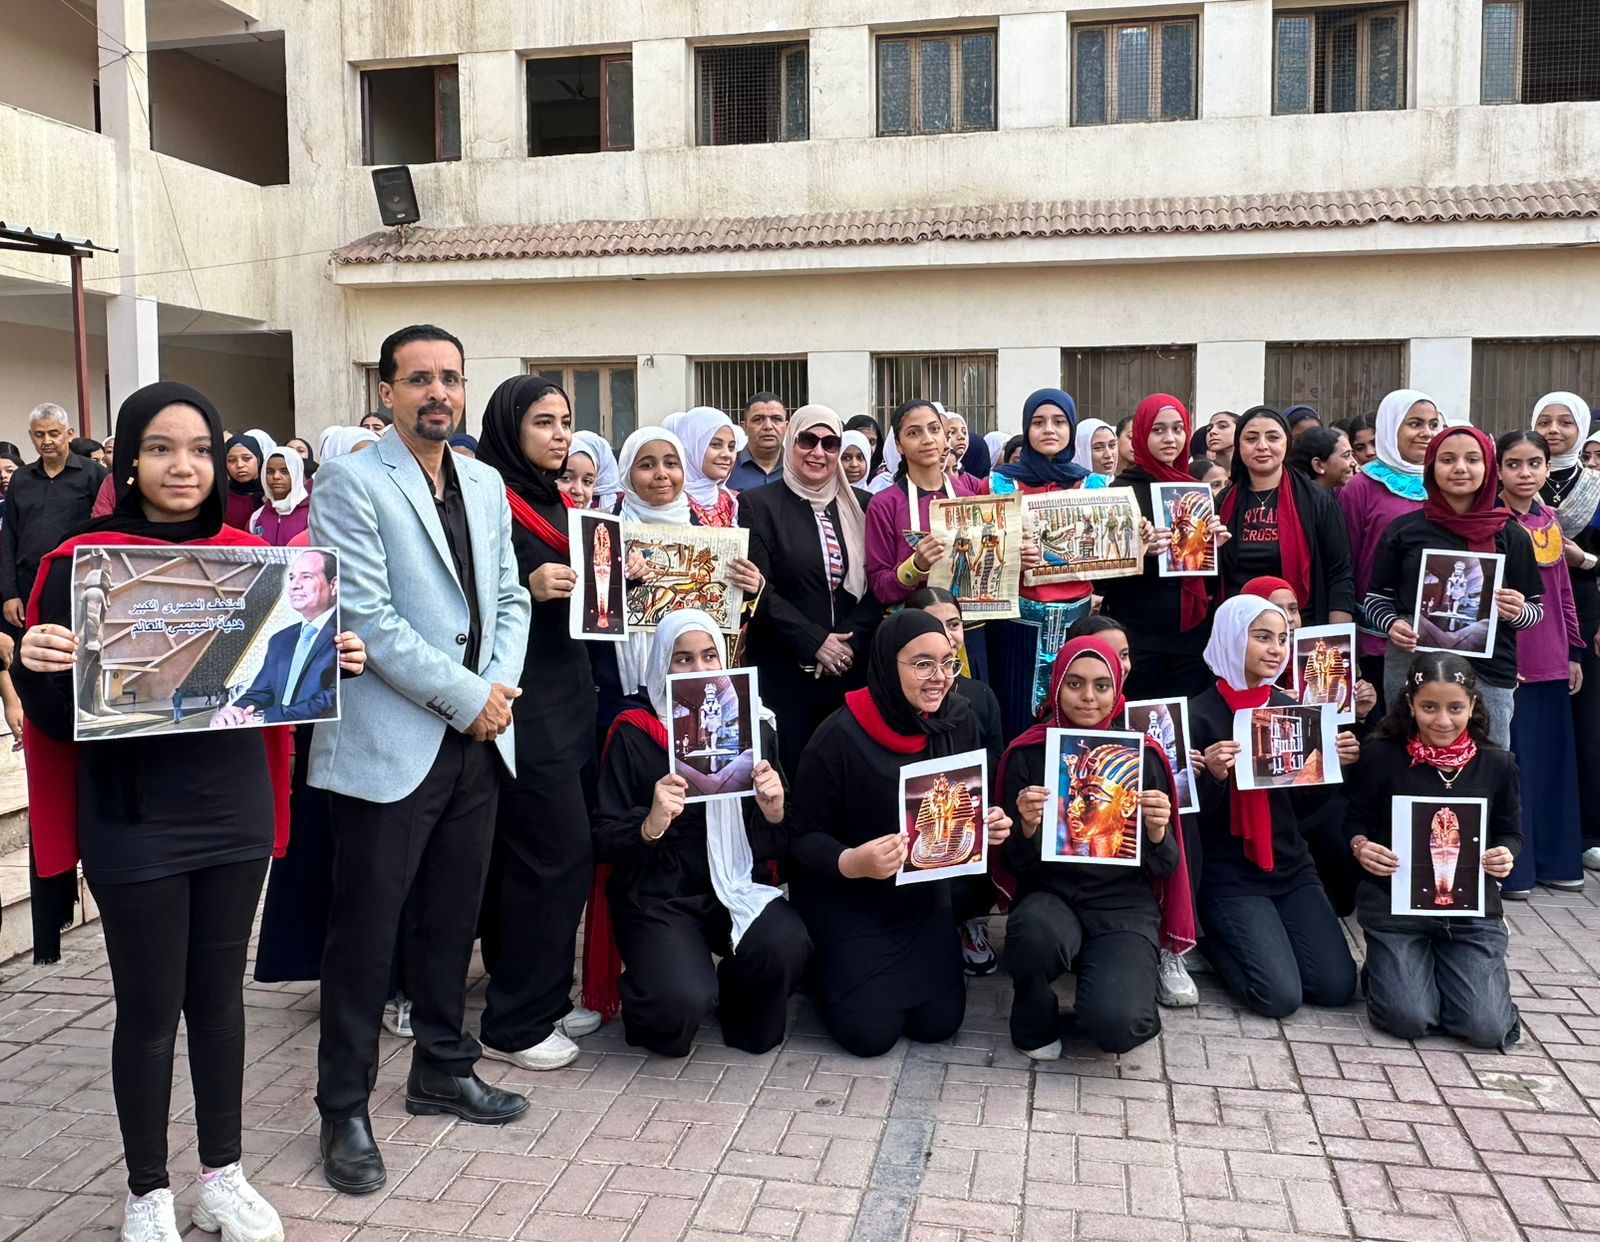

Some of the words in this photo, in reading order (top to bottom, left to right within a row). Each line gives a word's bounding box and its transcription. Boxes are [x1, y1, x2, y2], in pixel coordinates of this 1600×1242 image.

[128, 598, 159, 614] الكبير
[206, 598, 246, 610] المتحف
[131, 618, 165, 639] للعالم
[217, 615, 244, 633] هدية
